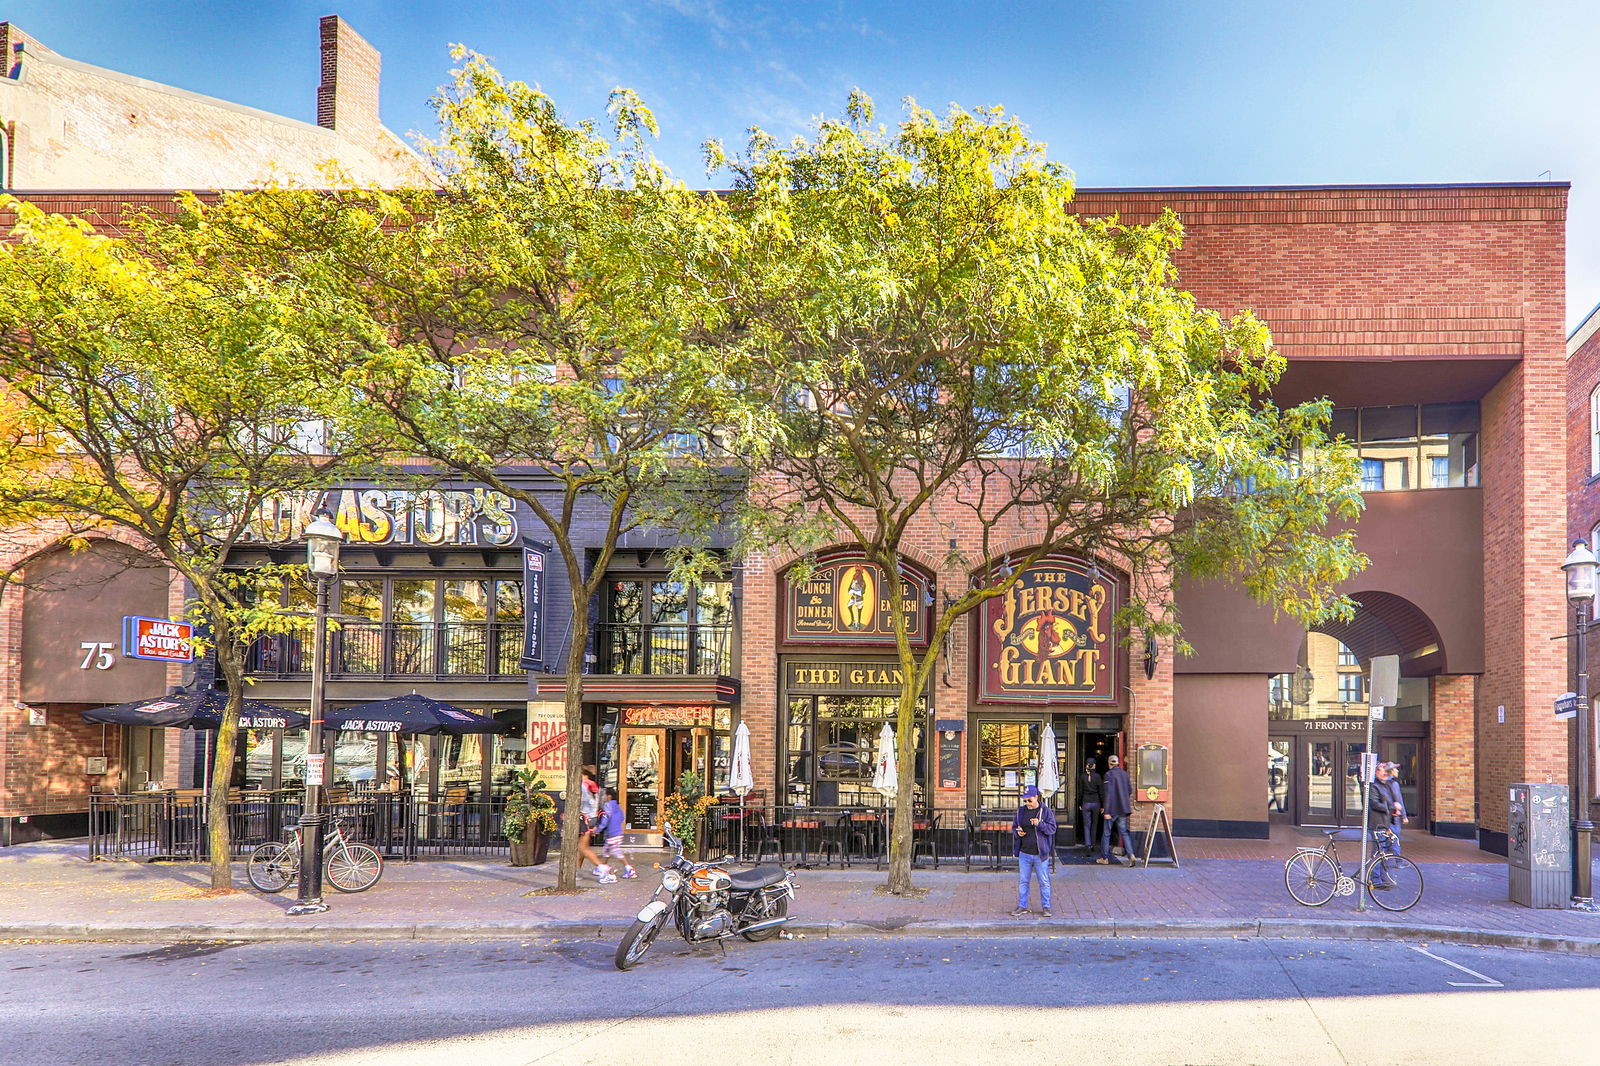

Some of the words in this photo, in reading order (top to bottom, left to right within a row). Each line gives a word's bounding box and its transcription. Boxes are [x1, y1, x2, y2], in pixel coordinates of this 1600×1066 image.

[335, 488, 519, 547] ASTOR'S
[1033, 572, 1067, 583] THE
[801, 582, 831, 595] LUNCH
[810, 595, 823, 605] &
[880, 600, 917, 612] ENISH
[798, 606, 833, 618] DINNER
[993, 579, 1107, 642] JERSEY
[149, 622, 180, 638] JACK
[139, 634, 189, 652] ASTOR'S
[80, 642, 116, 670] 75
[1000, 646, 1100, 687] GIANT
[795, 669, 840, 684] THE
[850, 669, 904, 684] GIAN
[676, 706, 712, 720] OPEN
[252, 717, 286, 729] ASTOR'S
[340, 720, 365, 731] JACK
[365, 721, 403, 732] ASTOR'S
[1304, 722, 1313, 730] 71
[1315, 722, 1350, 730] FRONT
[1351, 722, 1365, 730] ST.
[531, 721, 567, 745] CRAF
[538, 740, 557, 755] COMING
